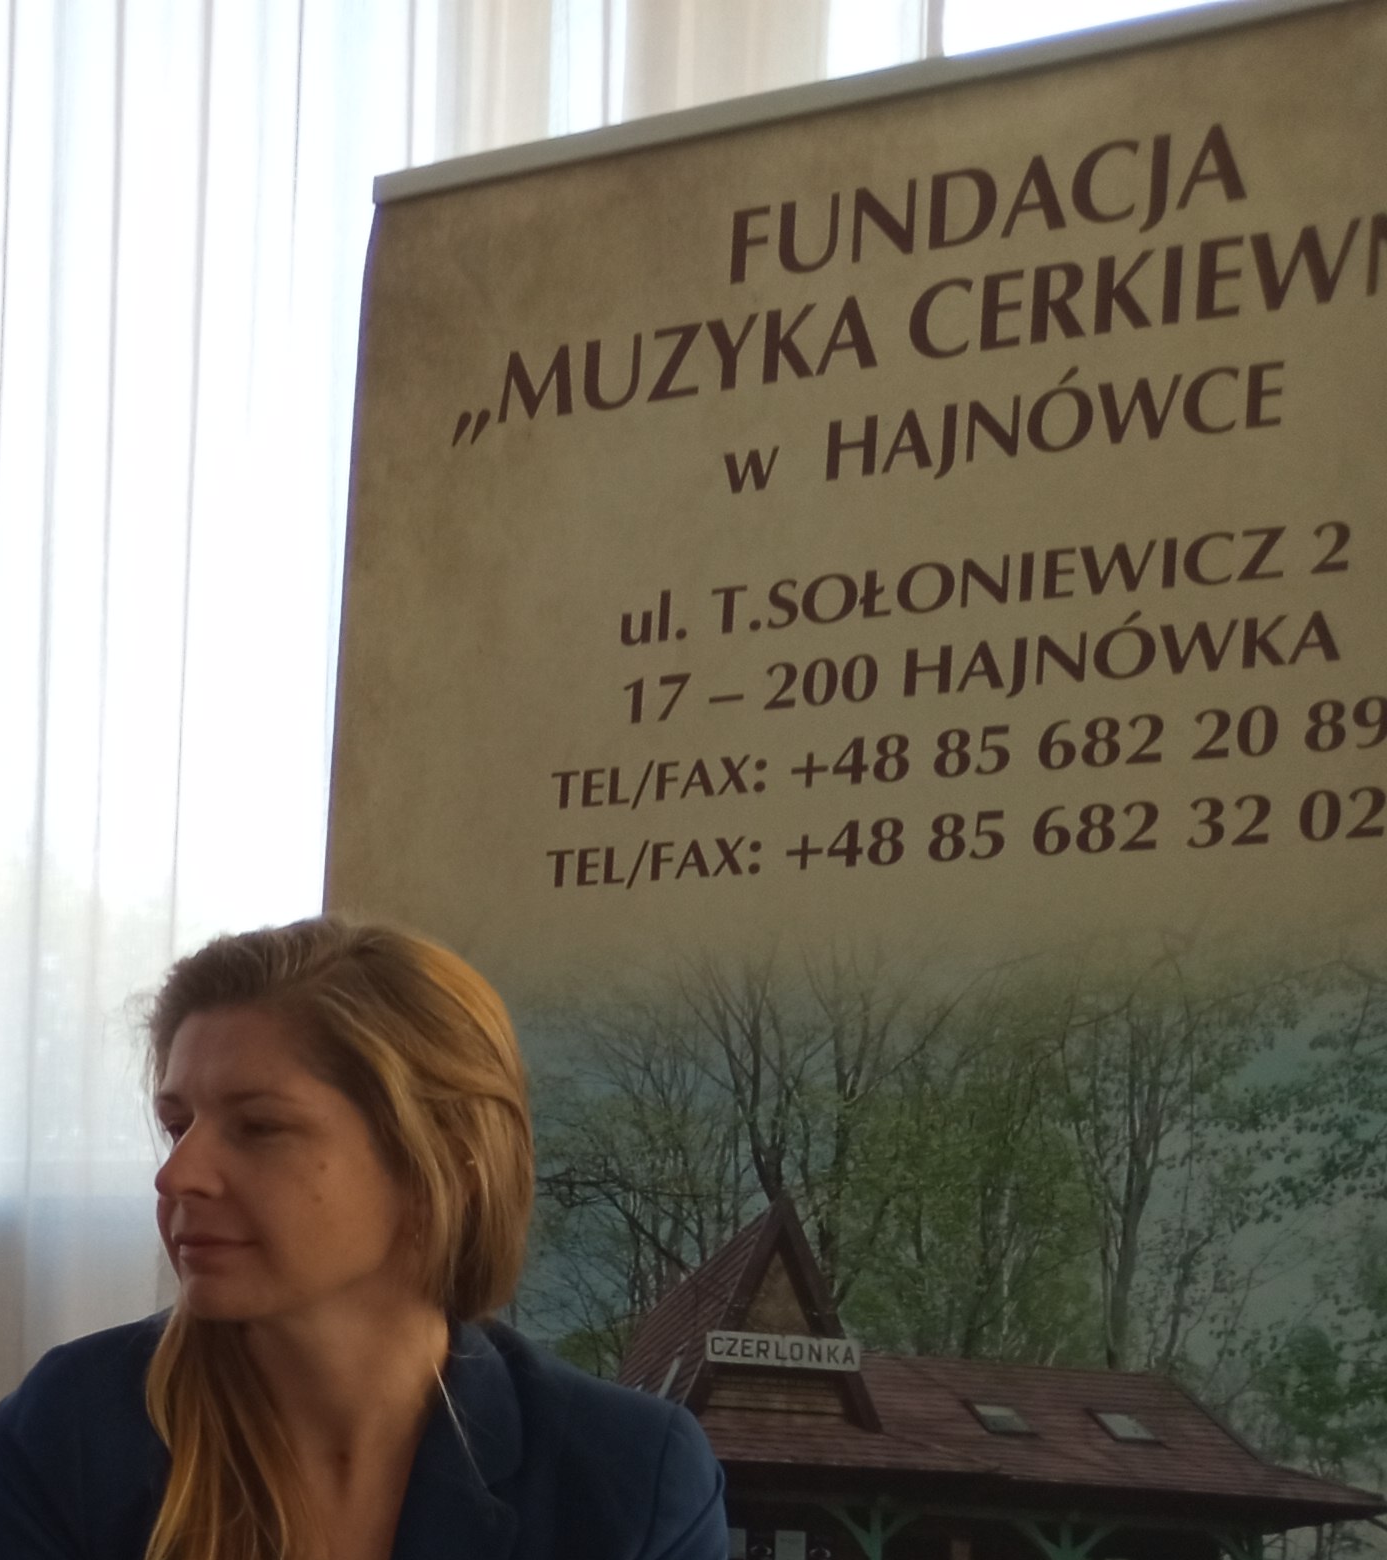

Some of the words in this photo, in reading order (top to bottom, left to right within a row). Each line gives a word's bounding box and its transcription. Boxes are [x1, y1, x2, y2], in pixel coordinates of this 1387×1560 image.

[728, 122, 1248, 286] FUNDACJA
[451, 295, 878, 448] „MUZYKA
[825, 361, 1285, 481] HAJNÓWCE
[620, 589, 689, 647] ul.
[1310, 521, 1351, 575] 2
[622, 673, 691, 724] 17
[763, 654, 879, 711] 200
[902, 610, 1341, 699] HAJNÓWKA
[551, 755, 769, 811] TEL/FAX:
[791, 733, 911, 790] +48
[932, 725, 1011, 779] 85
[1037, 713, 1165, 770] 682
[1191, 704, 1279, 761] 20
[1303, 695, 1387, 753] 89
[546, 835, 763, 889] TEL/FAX:
[785, 816, 905, 870] +48
[927, 810, 1006, 864] 85
[1032, 801, 1160, 856] 682
[1186, 793, 1271, 849] 32
[1298, 786, 1387, 844] 02
[710, 1336, 856, 1366] CZERLONKA
